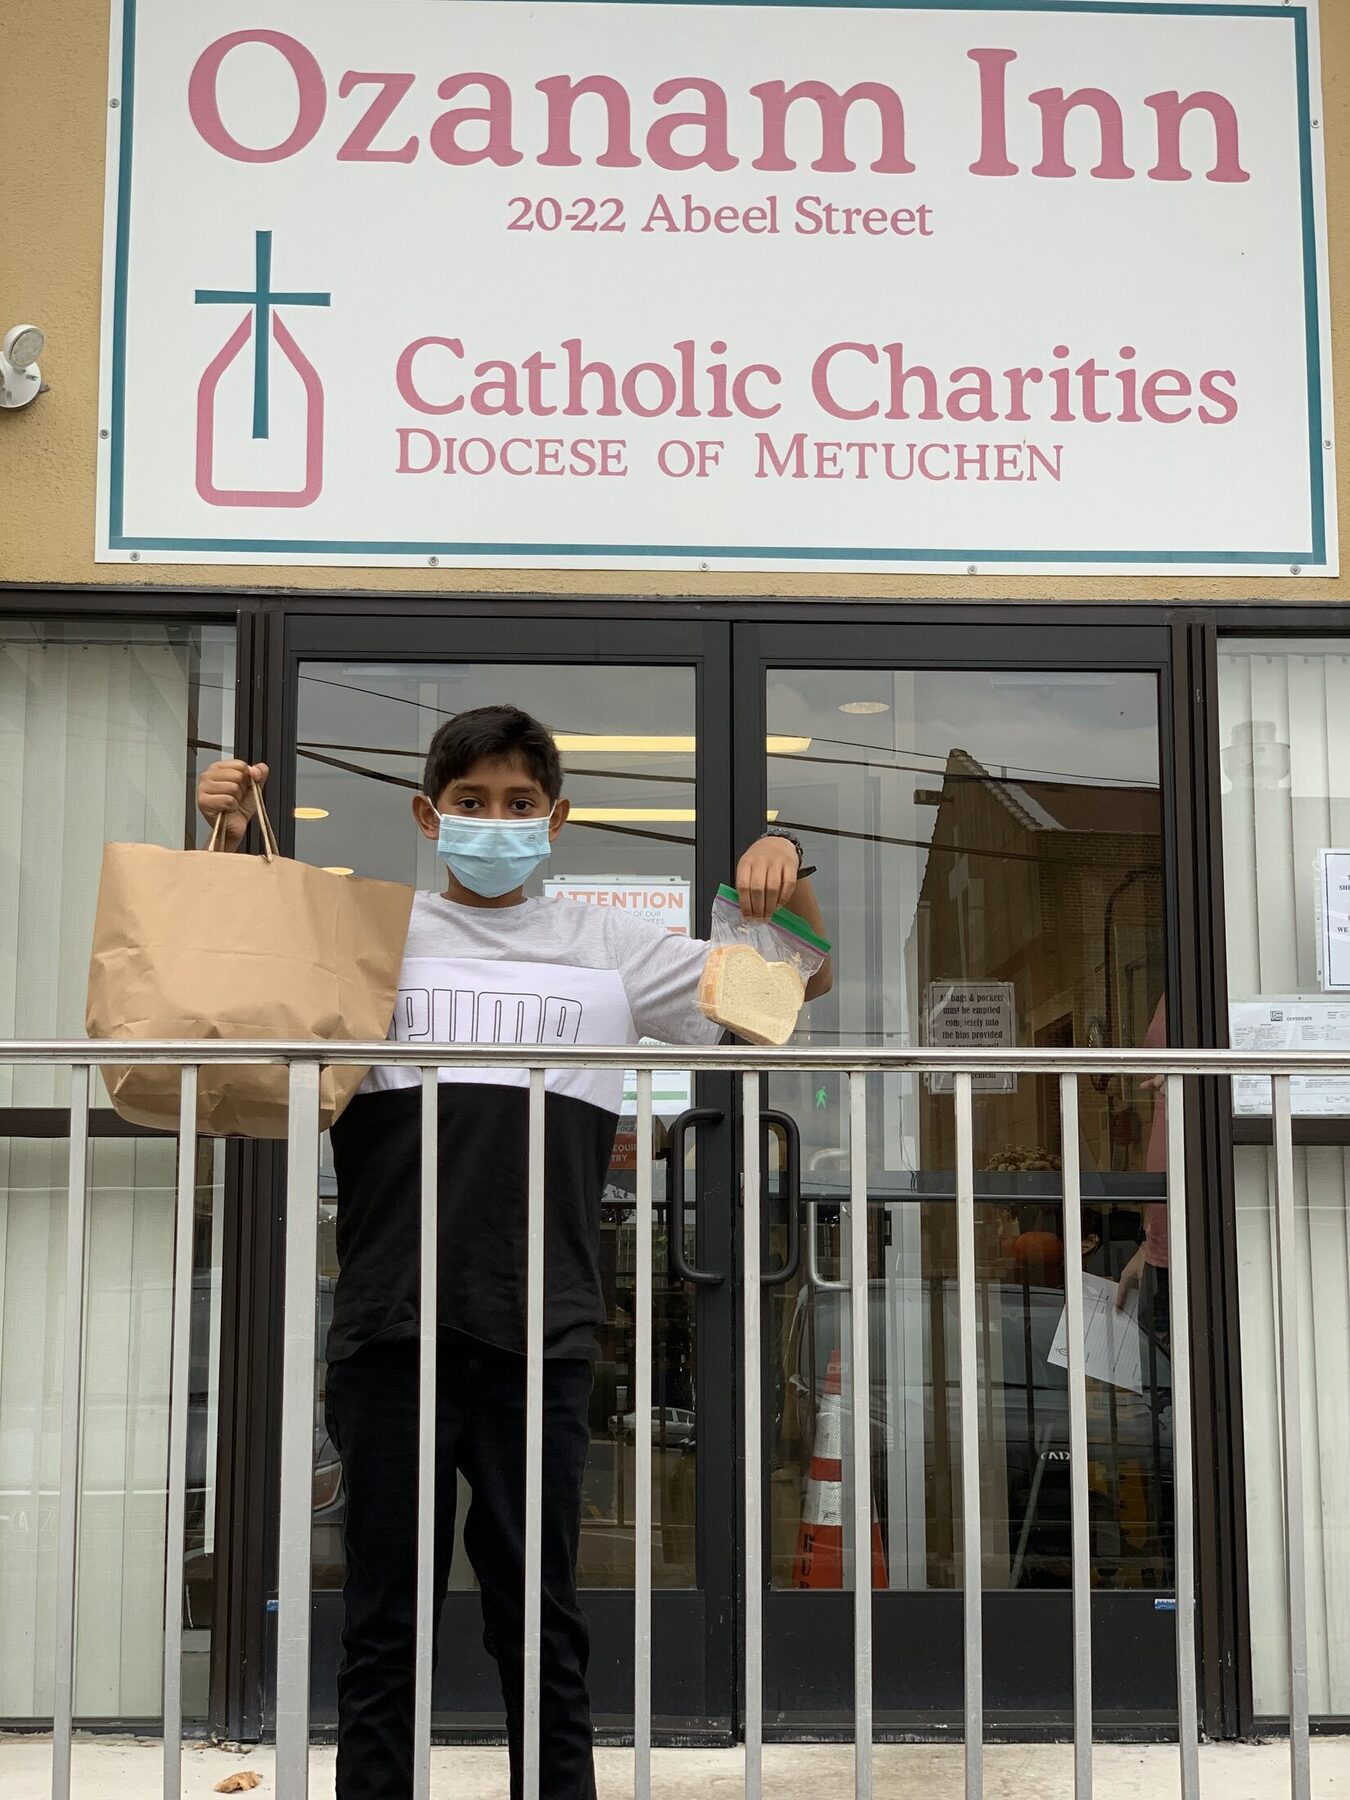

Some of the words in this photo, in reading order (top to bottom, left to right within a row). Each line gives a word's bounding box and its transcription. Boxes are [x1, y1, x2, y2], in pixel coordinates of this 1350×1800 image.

[187, 28, 917, 175] Ozanam
[966, 47, 1250, 184] Inn
[507, 196, 626, 233] 20-22
[642, 193, 779, 234] Abeel
[794, 195, 932, 237] Street
[395, 335, 782, 419] Catholic
[811, 341, 1238, 425] Charities
[396, 427, 628, 477] DIOCESE
[656, 439, 724, 478] OF
[755, 431, 1063, 482] METUCHEN
[943, 1006, 959, 1014] must
[962, 1006, 971, 1014] be
[972, 1006, 1001, 1015] emptied
[977, 994, 1003, 1003] pockets
[942, 1031, 954, 1039] the
[972, 1031, 1003, 1040] provided
[611, 1153, 627, 1162] TRY
